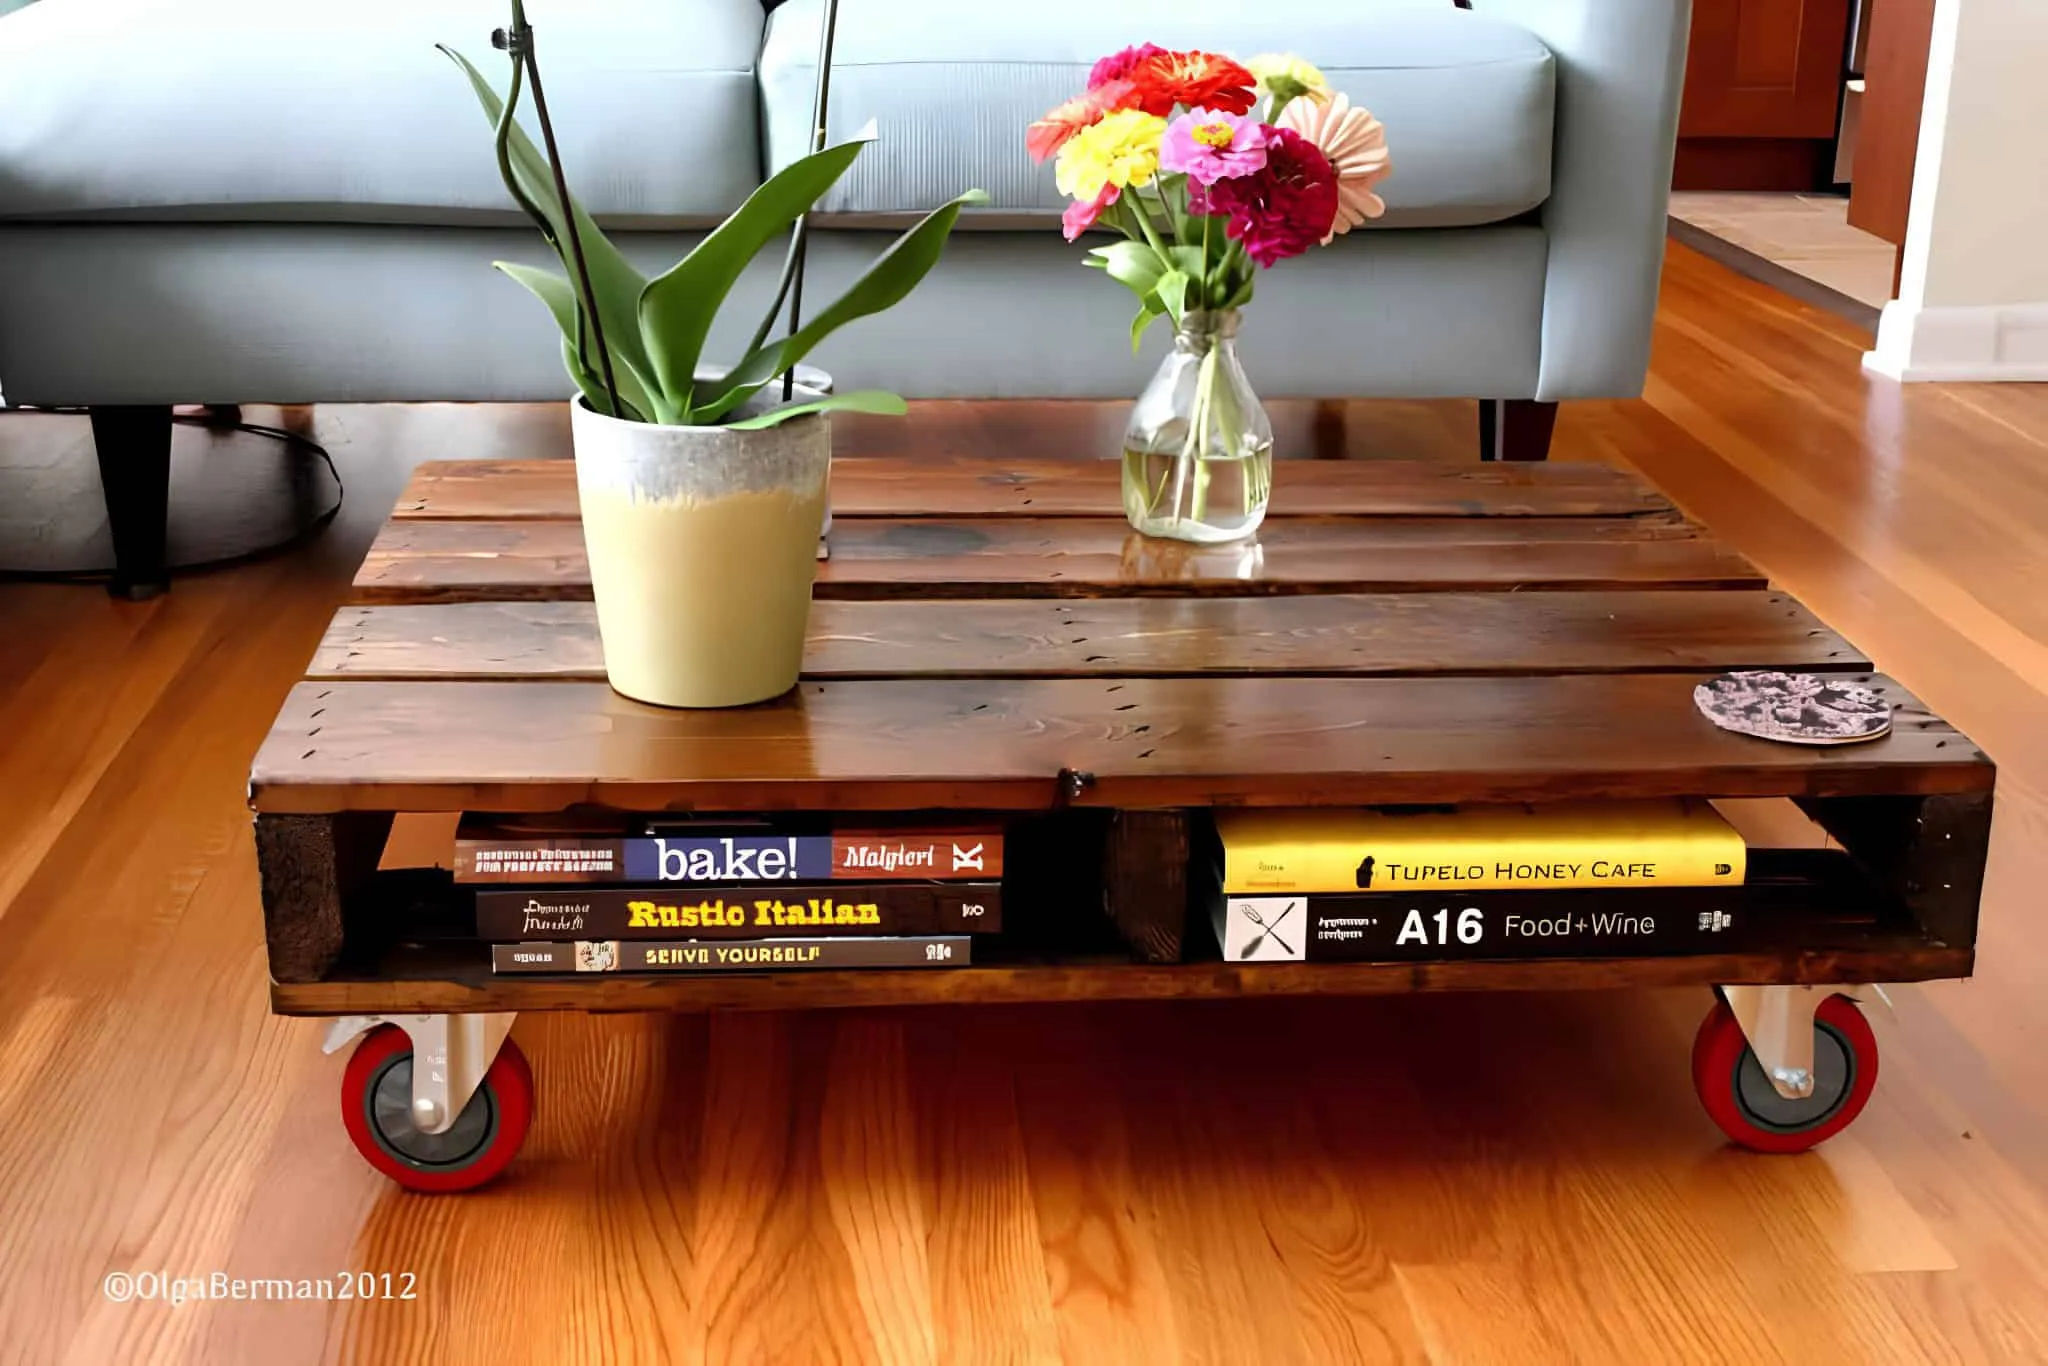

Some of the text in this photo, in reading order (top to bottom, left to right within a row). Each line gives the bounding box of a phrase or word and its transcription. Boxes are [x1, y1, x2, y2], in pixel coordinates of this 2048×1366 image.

[655, 837, 798, 881] bake!
[952, 842, 984, 872] K
[1386, 860, 1657, 882] TUPELO HONEY CAFE
[627, 898, 881, 928] Rustic Italian
[1396, 907, 1485, 946] A16
[1504, 911, 1656, 937] Food+Wine
[716, 946, 821, 964] YOURSELF
